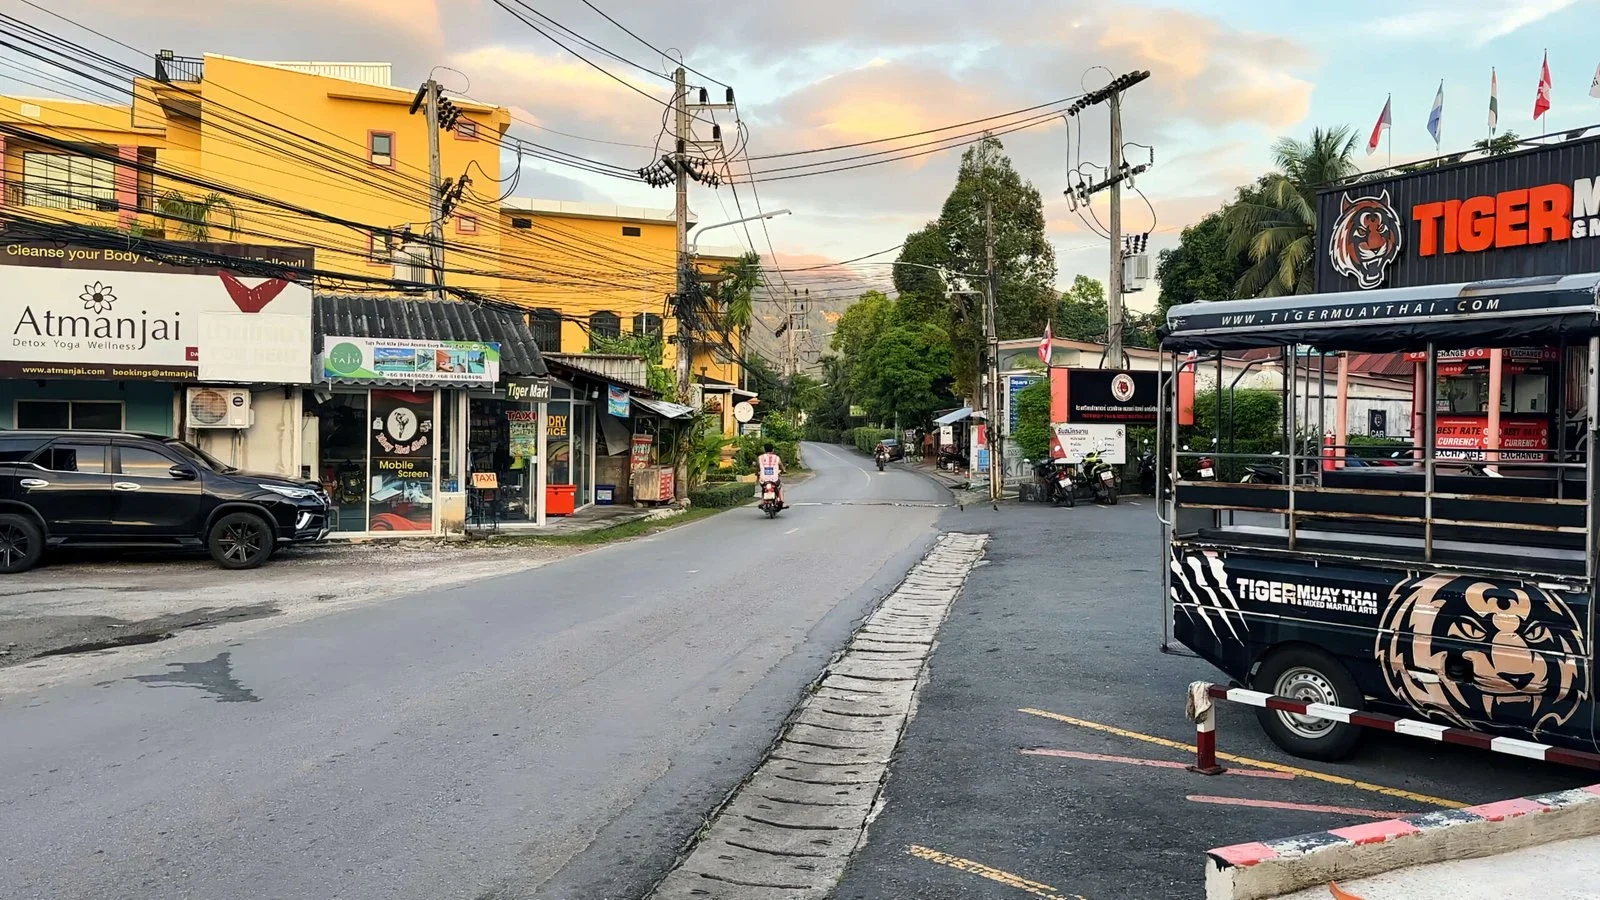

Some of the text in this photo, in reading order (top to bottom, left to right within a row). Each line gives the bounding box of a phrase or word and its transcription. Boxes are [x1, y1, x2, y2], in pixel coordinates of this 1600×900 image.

[1412, 183, 1573, 257] TIGER
[1572, 219, 1588, 238] &
[6, 244, 65, 258] Cleanse
[68, 249, 100, 261] your
[104, 249, 140, 264] Body
[13, 305, 180, 350] Atmanjai
[12, 338, 136, 351] Detox Yoga Wellness
[22, 366, 105, 376] www.atmanjai.com
[508, 383, 548, 399] Tiger Mart
[505, 410, 538, 421] TAXI
[546, 416, 567, 427] DRY
[1370, 430, 1385, 438] CAR
[1436, 427, 1481, 435] BEST RATE
[1437, 437, 1479, 446] CURRENCY
[1504, 439, 1539, 447] CURRENCY
[1501, 452, 1542, 460] EXCHANGE
[379, 461, 414, 469] Mobile
[397, 470, 429, 478] Screen
[474, 473, 496, 482] TAXI
[1236, 577, 1378, 607] TIGER MUAY THAI
[1303, 600, 1325, 608] MIXED
[1326, 602, 1357, 613] MARTIAL
[1358, 605, 1378, 615] ARTS
